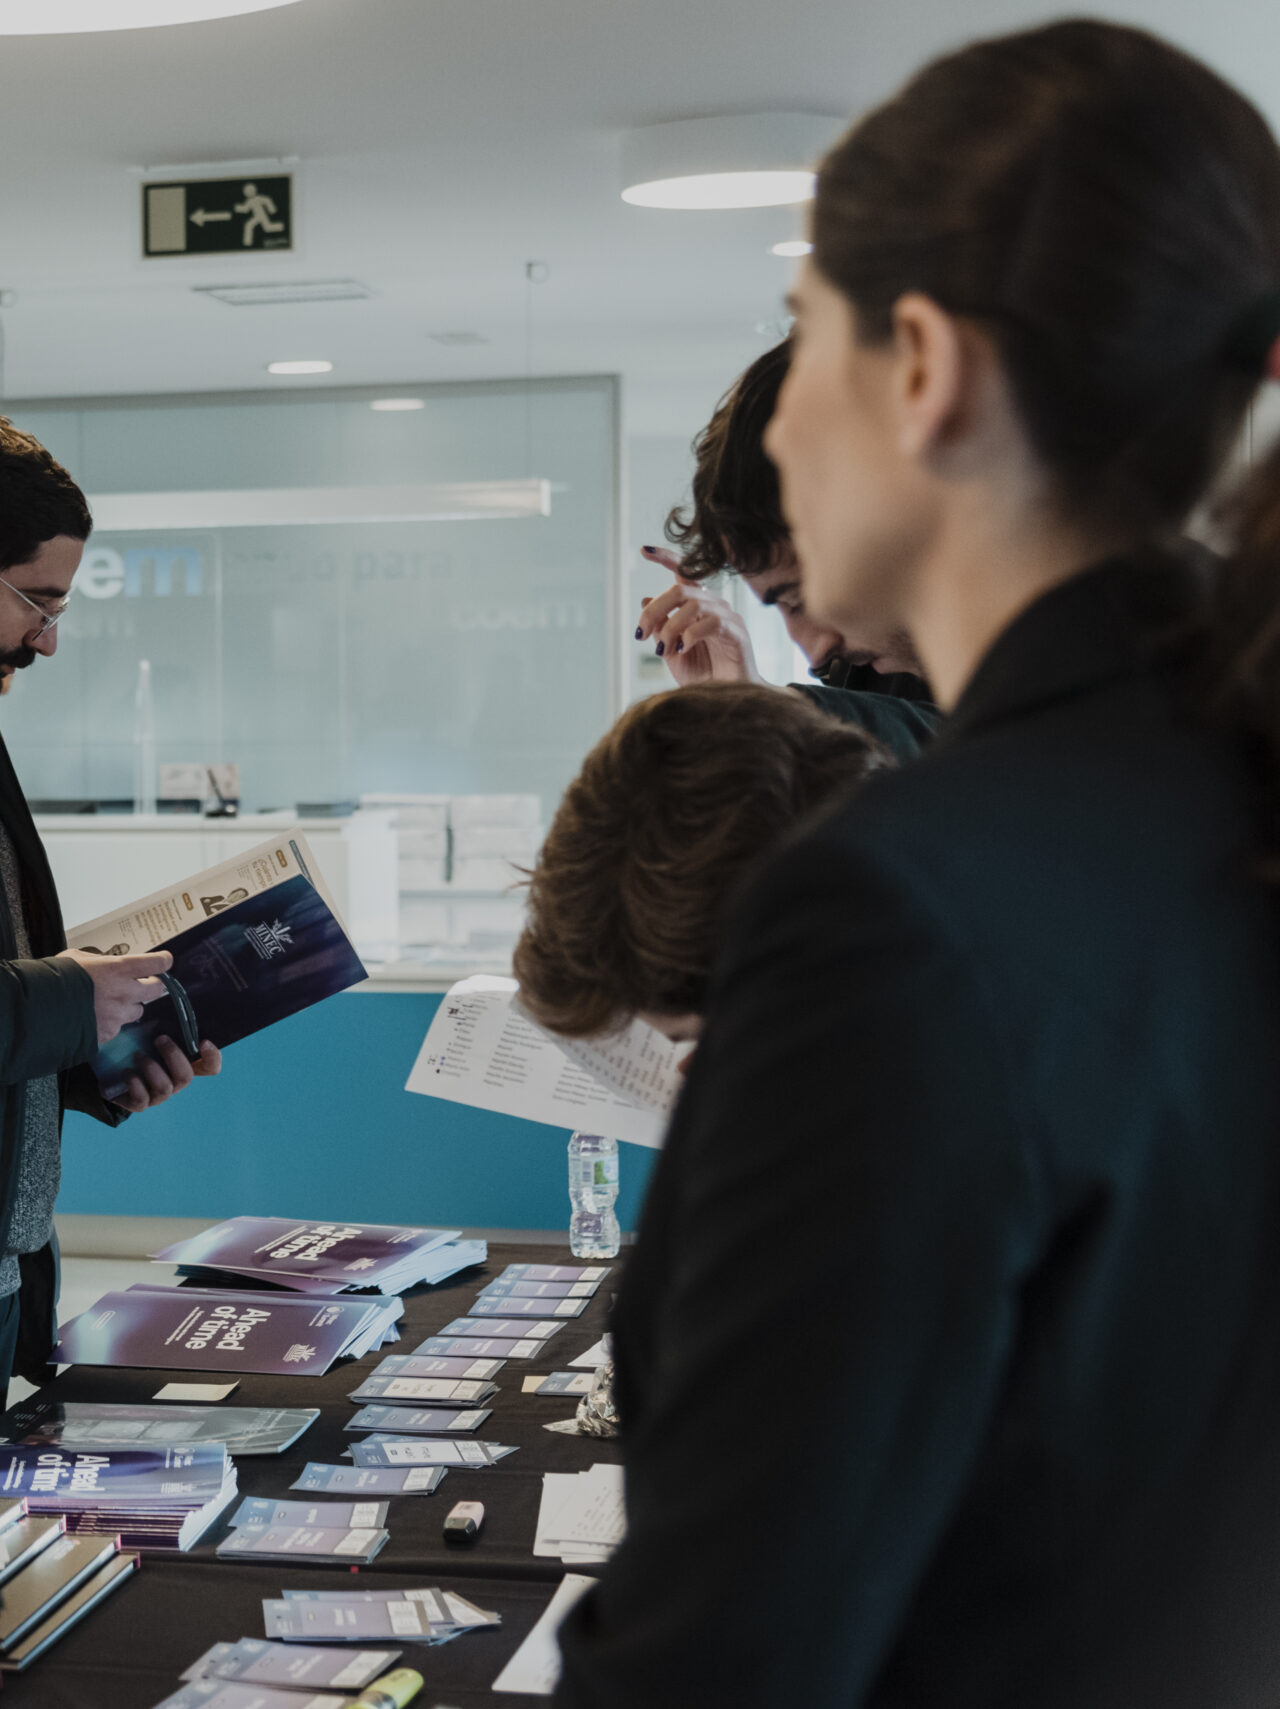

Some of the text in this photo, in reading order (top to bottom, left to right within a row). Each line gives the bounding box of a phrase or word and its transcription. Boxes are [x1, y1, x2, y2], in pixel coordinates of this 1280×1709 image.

[76, 547, 202, 599] em
[253, 923, 282, 955] MINEC
[269, 1235, 321, 1259] time
[293, 1227, 362, 1261] Ahead
[310, 1225, 336, 1236] of
[210, 1305, 238, 1319] of
[215, 1307, 271, 1350] Ahead
[184, 1319, 229, 1350] time
[30, 1453, 71, 1491] of time
[70, 1454, 110, 1491] Ahead
